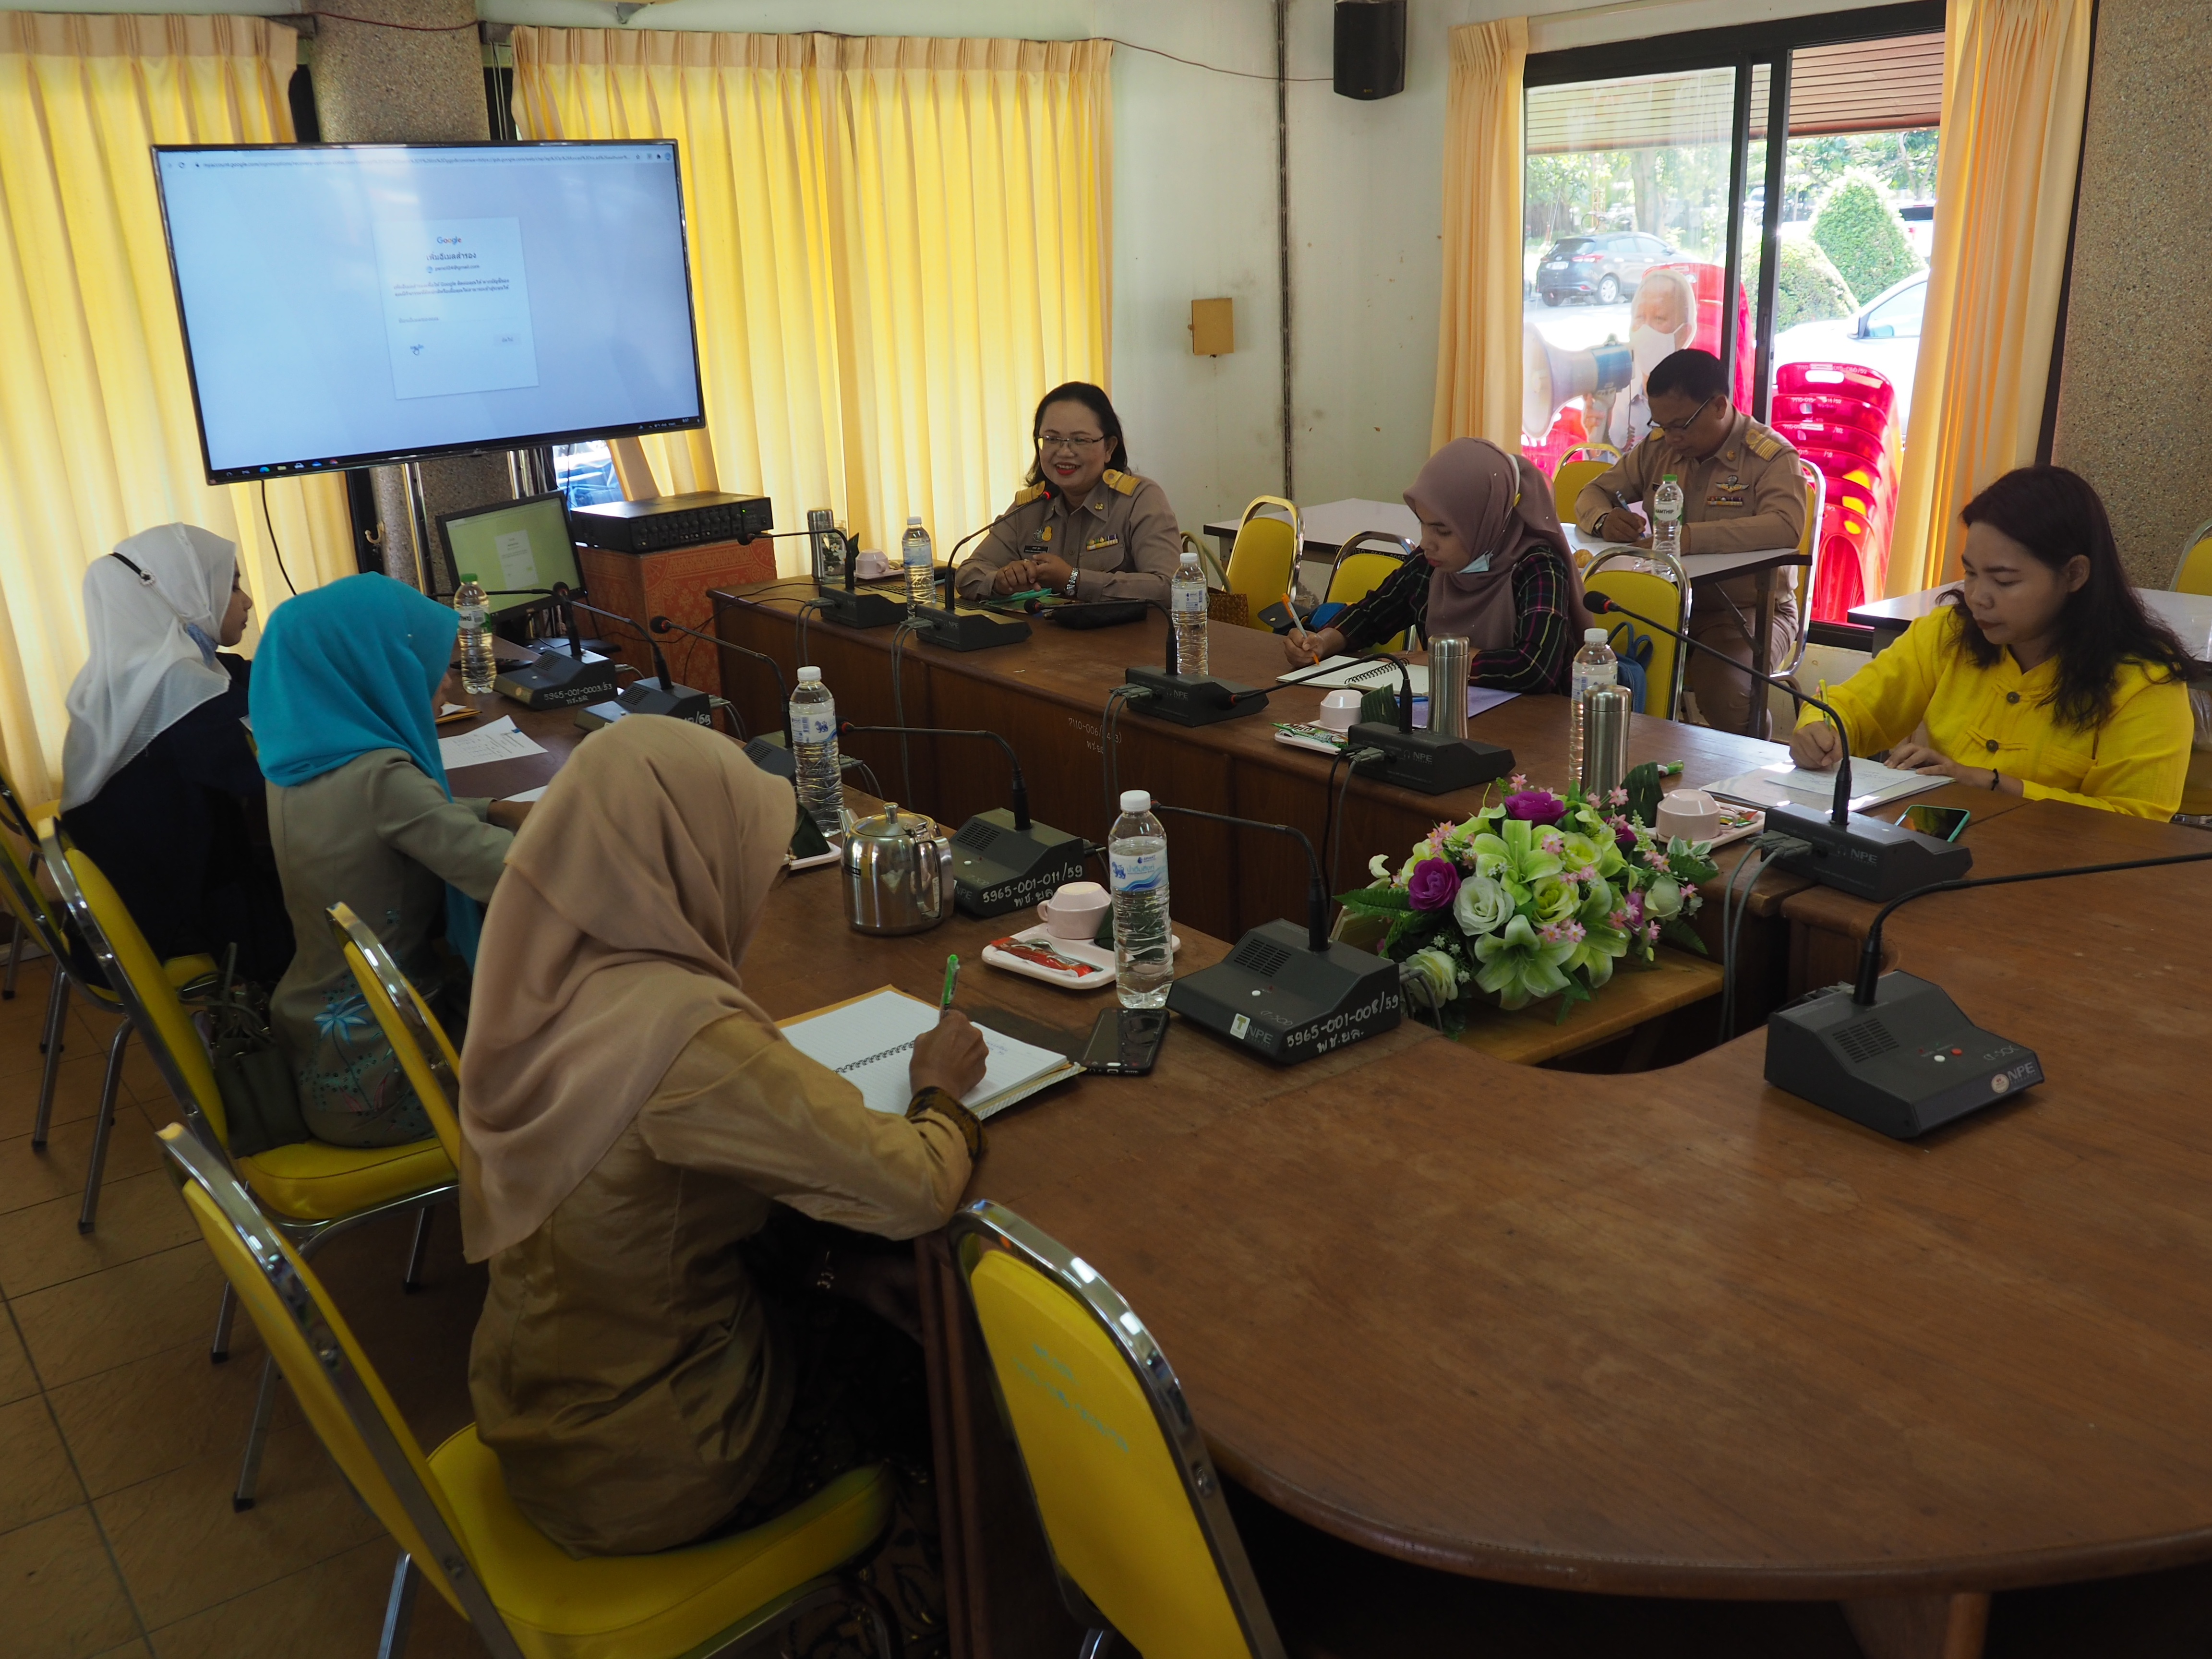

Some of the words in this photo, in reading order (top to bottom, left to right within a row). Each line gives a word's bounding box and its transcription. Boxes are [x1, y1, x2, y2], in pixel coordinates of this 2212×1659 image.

[437, 236, 462, 245] Google
[426, 252, 476, 261] เพิ่มอีเมลสำรอง
[1173, 689, 1189, 699] NPE
[1413, 751, 1432, 763] NPE
[1851, 848, 1878, 864] NPE
[982, 862, 1083, 903] 5965-001-011/59
[954, 885, 973, 900] NPE
[1286, 991, 1399, 1047] 5965-001-008/59
[1248, 1024, 1274, 1045] NPE
[2007, 1061, 2036, 1082] NPE
